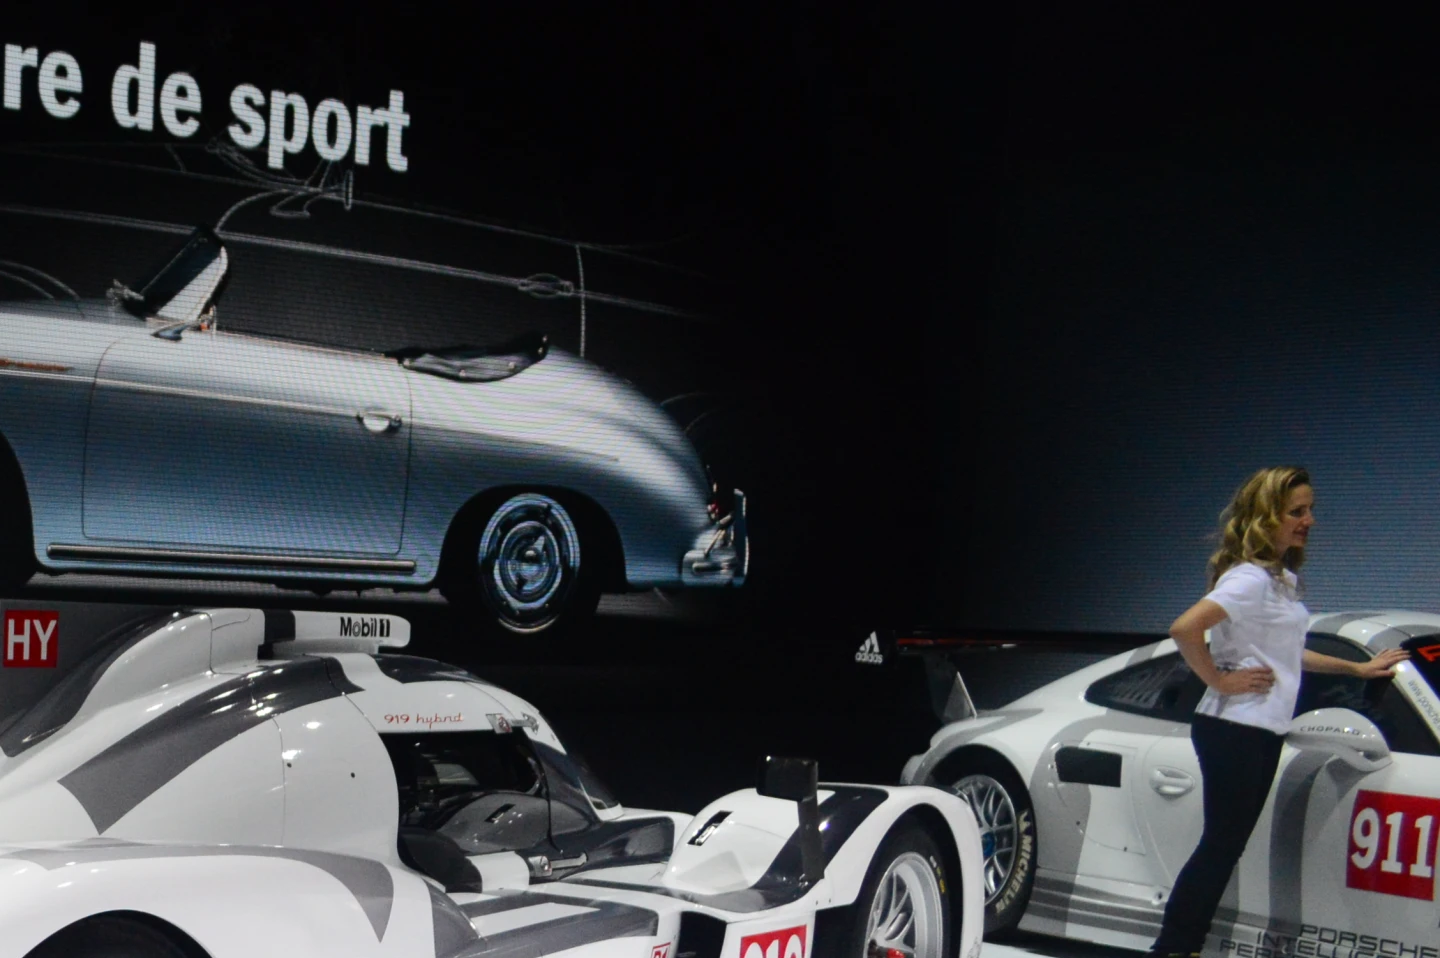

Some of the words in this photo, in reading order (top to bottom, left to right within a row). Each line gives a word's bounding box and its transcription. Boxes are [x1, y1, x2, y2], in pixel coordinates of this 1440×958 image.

[111, 41, 202, 138] de
[227, 83, 410, 172] sport
[5, 617, 59, 662] HY
[340, 616, 377, 638] Mobil
[379, 617, 390, 638] 1
[384, 713, 411, 725] 919
[415, 712, 465, 729] hybrid
[1351, 806, 1434, 879] 911
[995, 834, 1032, 914] MICHELIN
